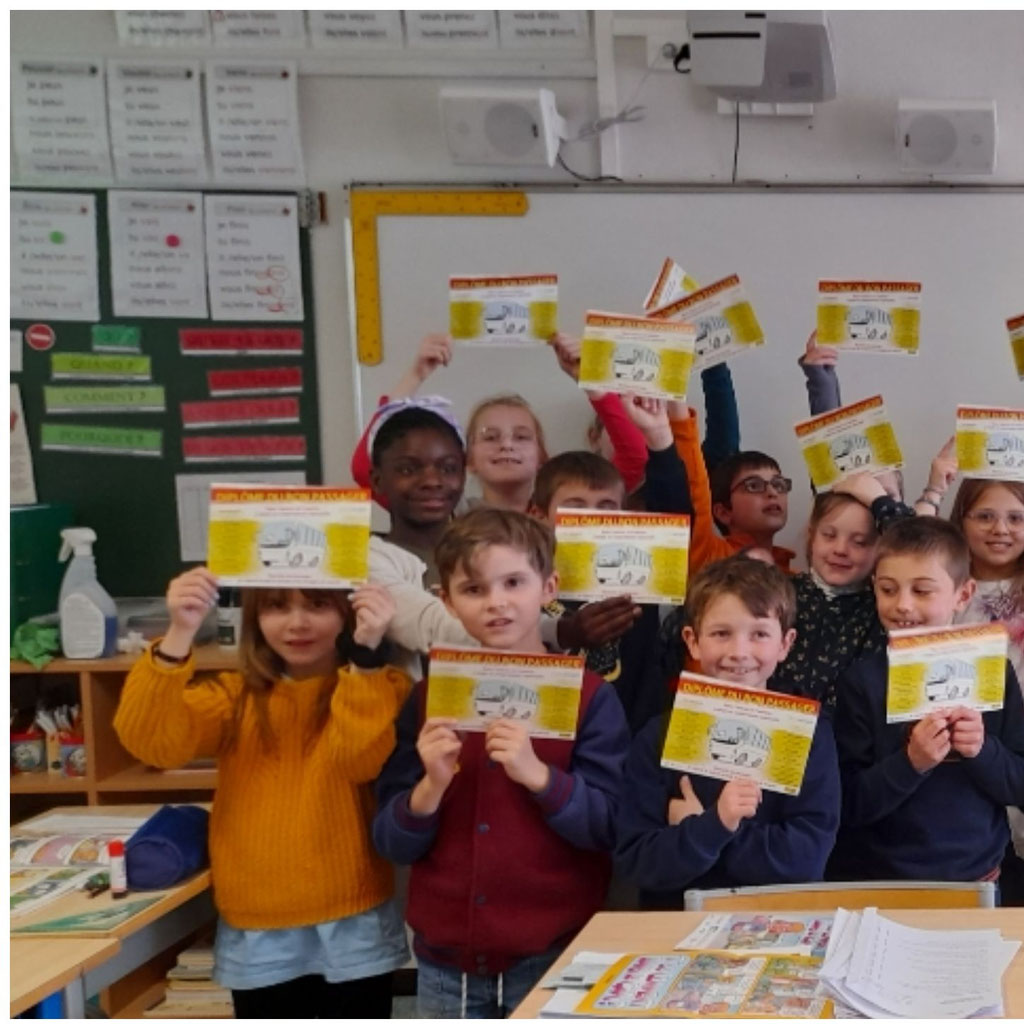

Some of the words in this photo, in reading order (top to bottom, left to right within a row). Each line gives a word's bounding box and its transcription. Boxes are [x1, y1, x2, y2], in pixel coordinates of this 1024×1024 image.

[71, 359, 123, 370] QUAND
[64, 391, 133, 402] COMMENT
[285, 492, 309, 502] BON
[618, 518, 637, 526] BON
[501, 655, 524, 665] BON
[742, 692, 762, 705] BON
[765, 695, 815, 713] PASSAGER
